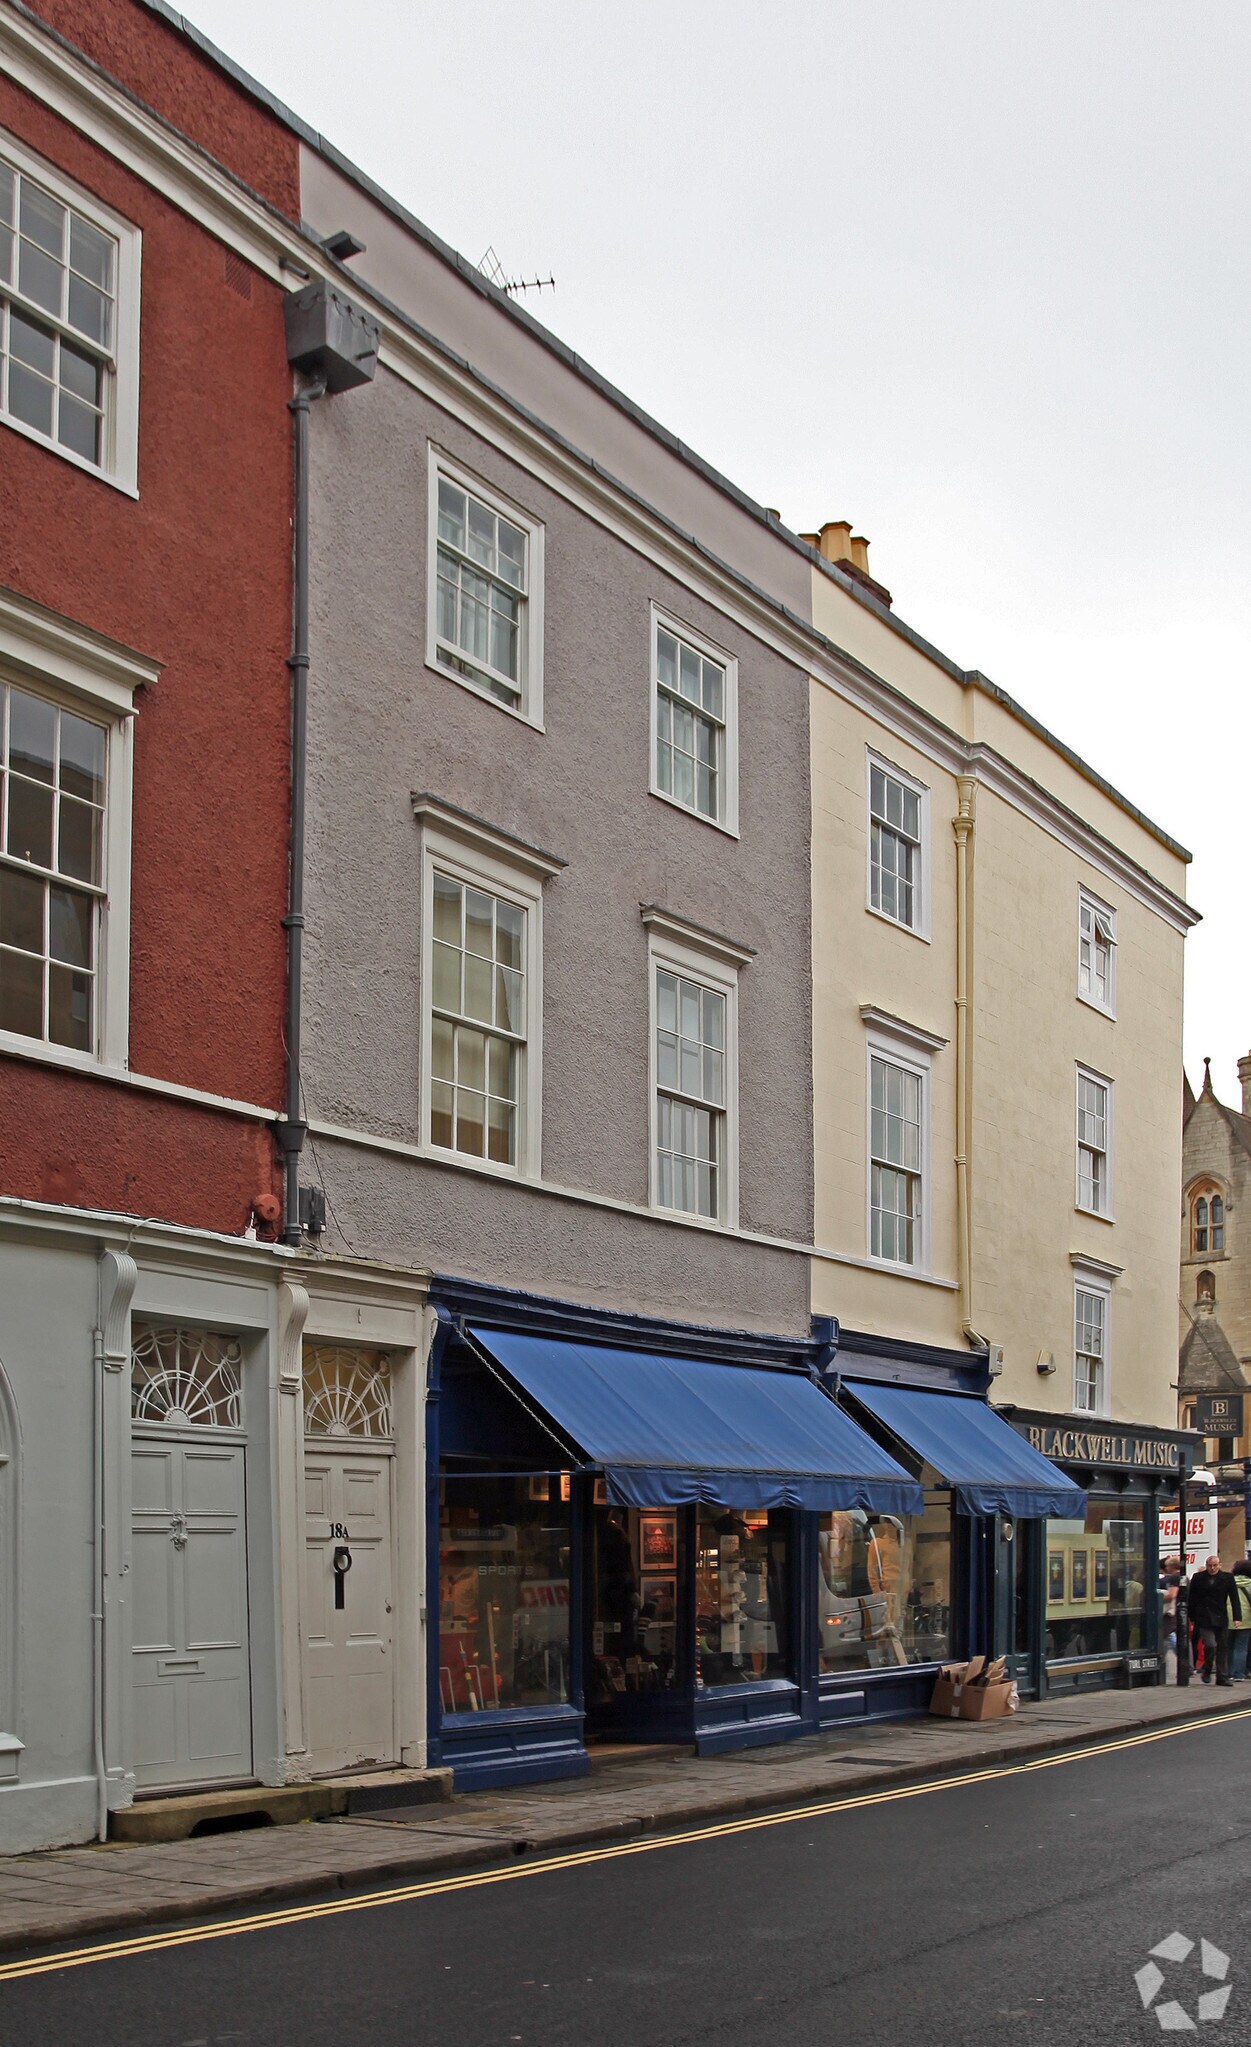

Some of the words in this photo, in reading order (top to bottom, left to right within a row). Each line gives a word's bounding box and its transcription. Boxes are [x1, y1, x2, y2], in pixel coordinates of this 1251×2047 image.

[1214, 1402, 1226, 1414] B
[1204, 1424, 1237, 1432] MUSIC
[1029, 1427, 1131, 1463] BLACKWELL
[1134, 1440, 1178, 1467] MUSIC
[329, 1522, 350, 1539] 18A
[1158, 1518, 1204, 1536] PEACES
[478, 1565, 536, 1576] SPORTS
